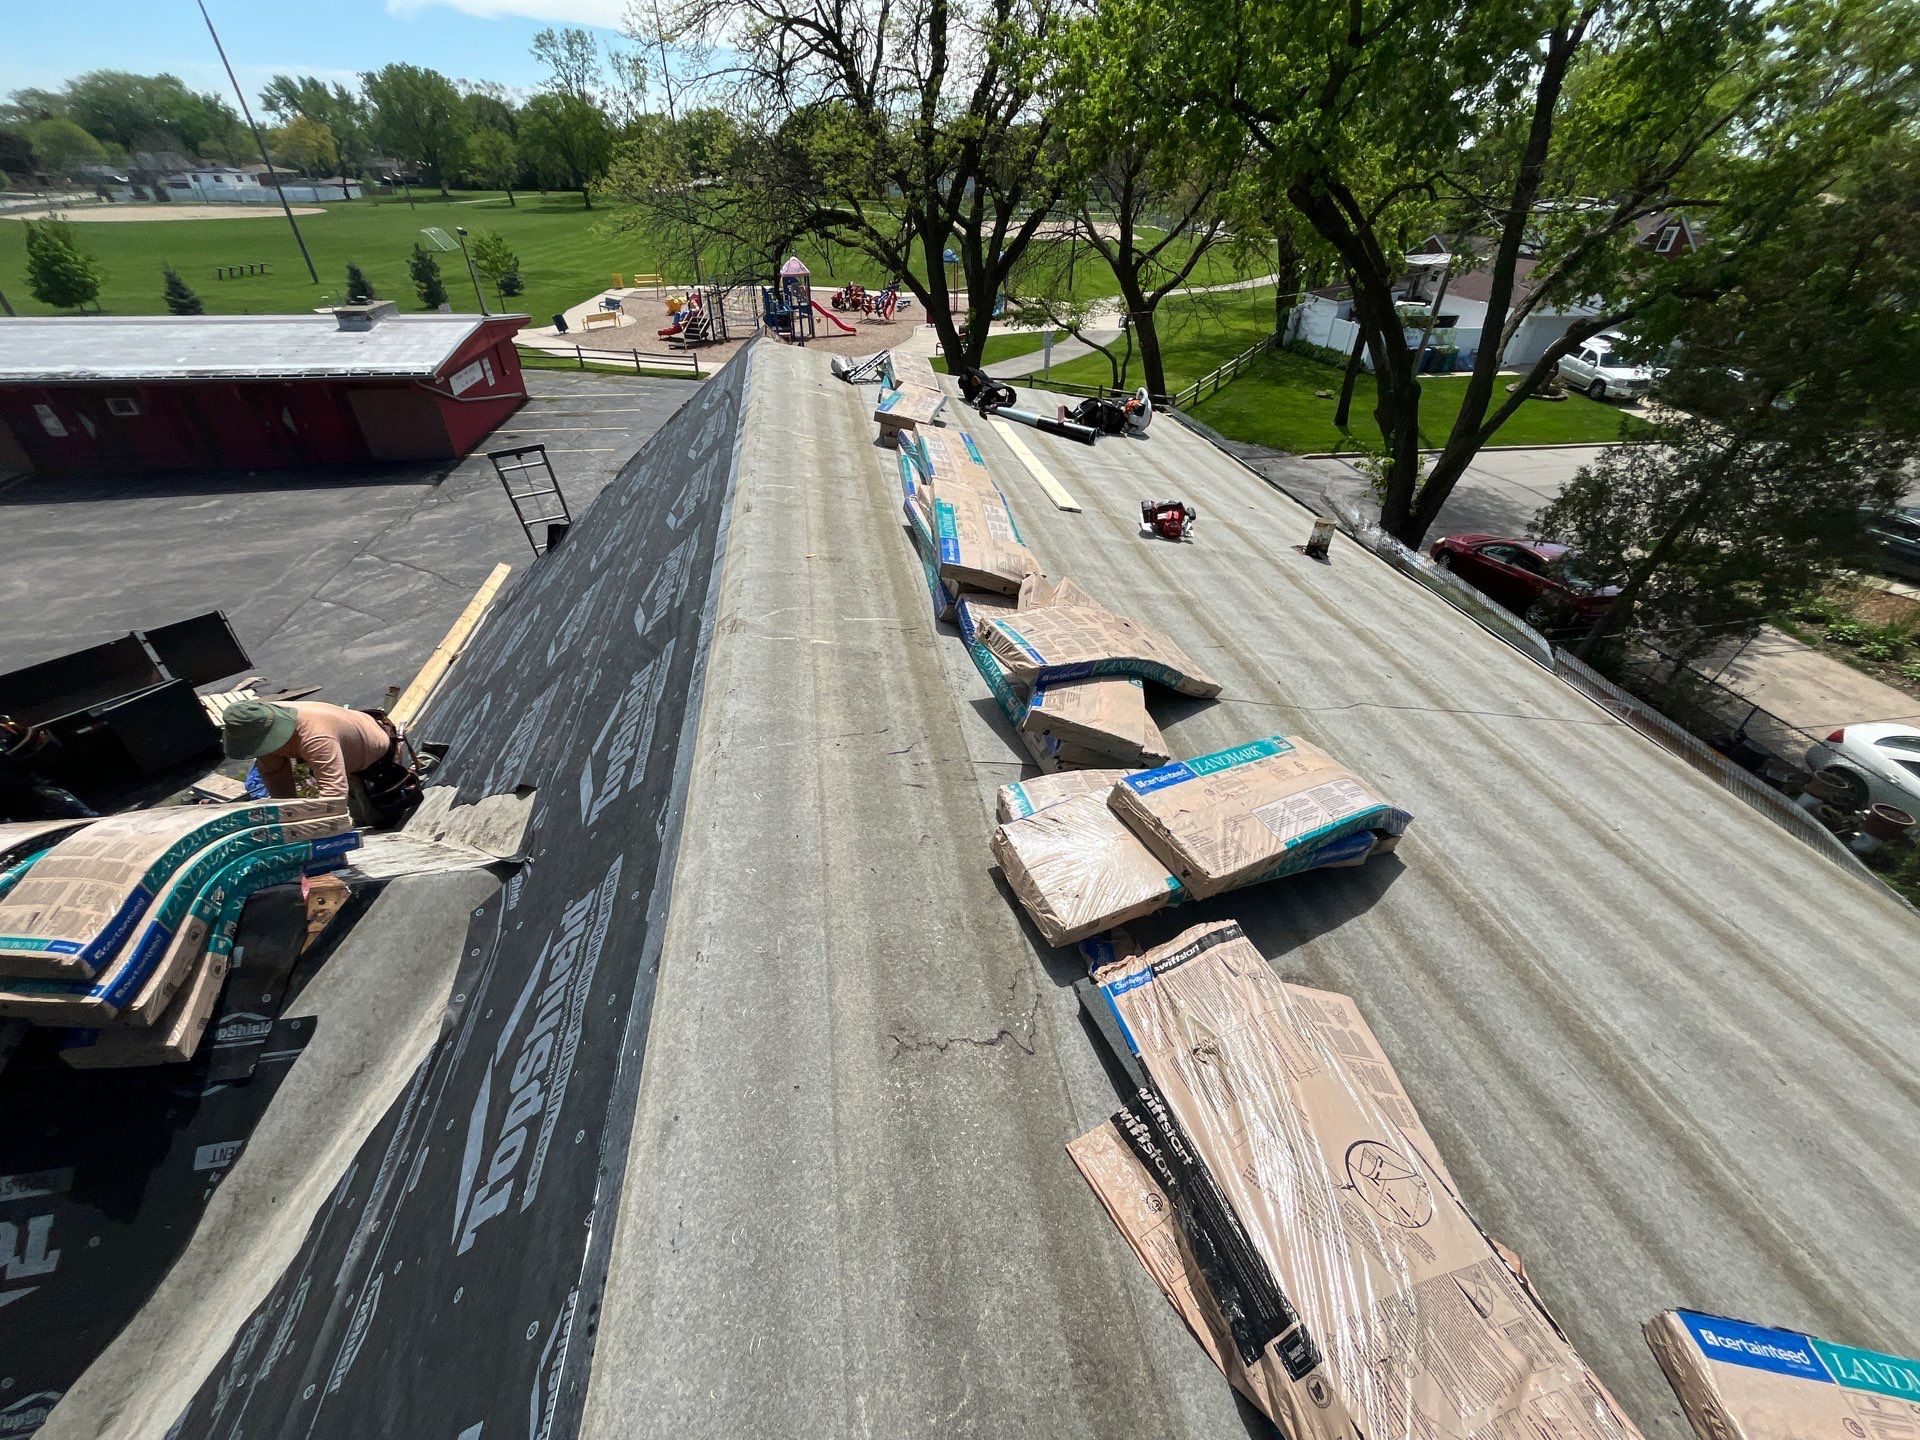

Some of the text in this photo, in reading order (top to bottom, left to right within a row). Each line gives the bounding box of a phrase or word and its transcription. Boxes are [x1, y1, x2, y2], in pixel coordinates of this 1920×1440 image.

[587, 659, 655, 826] TopShield
[1143, 745, 1264, 787] certainteed LANDMARK
[508, 874, 523, 910] Shield
[1154, 944, 1200, 972] swiftstart
[543, 1034, 577, 1130] SYNTHETIC
[570, 966, 592, 1033] ROOFING
[586, 866, 618, 965] UNDERLAYMENT
[457, 888, 597, 1256] TopShield
[1118, 1104, 1176, 1187] wiftstart
[1139, 1087, 1194, 1166] wiftstart
[1716, 1335, 1812, 1367] certainteed
